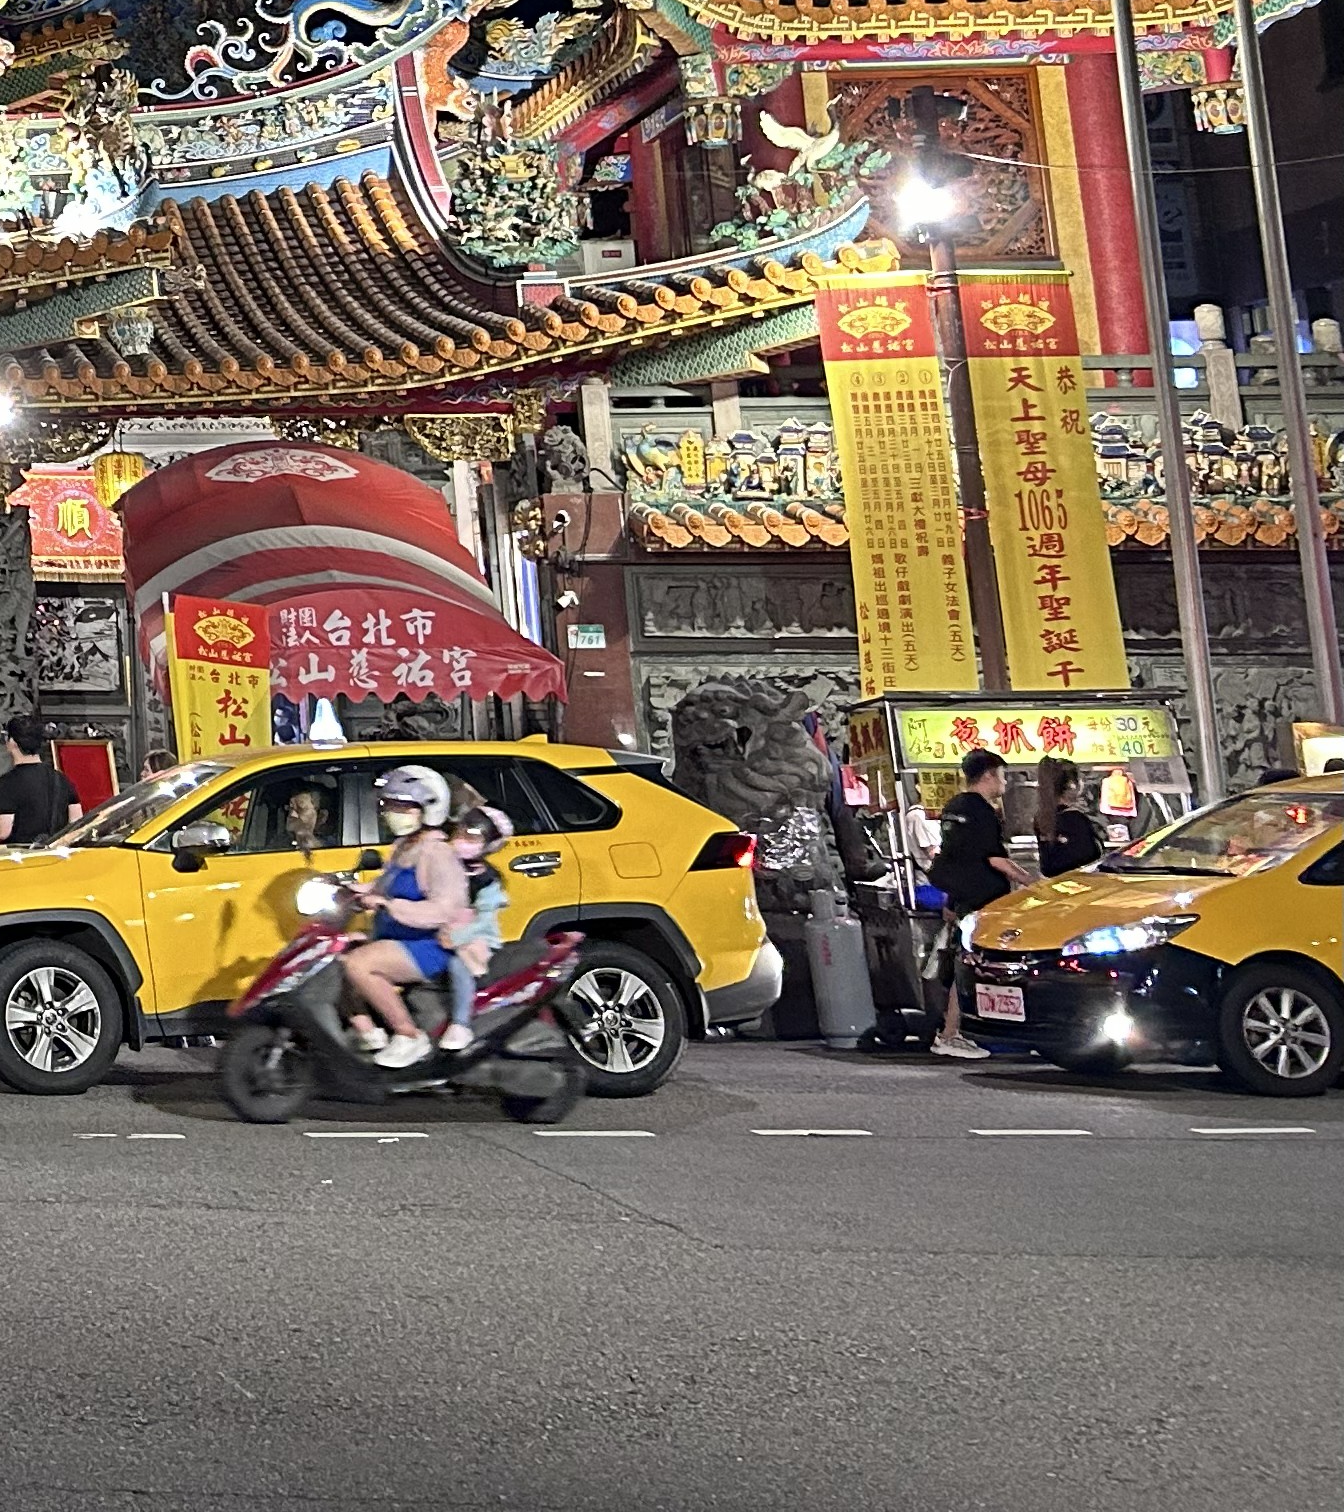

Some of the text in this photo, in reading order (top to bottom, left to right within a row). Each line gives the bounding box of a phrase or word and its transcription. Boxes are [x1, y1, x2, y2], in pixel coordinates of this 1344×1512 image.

[1056, 365, 1086, 435] 恭祝
[56, 498, 93, 540] 順
[281, 628, 320, 647] 法人
[322, 608, 436, 646] 台北市
[581, 635, 600, 645] 761
[210, 668, 259, 688] 台北市
